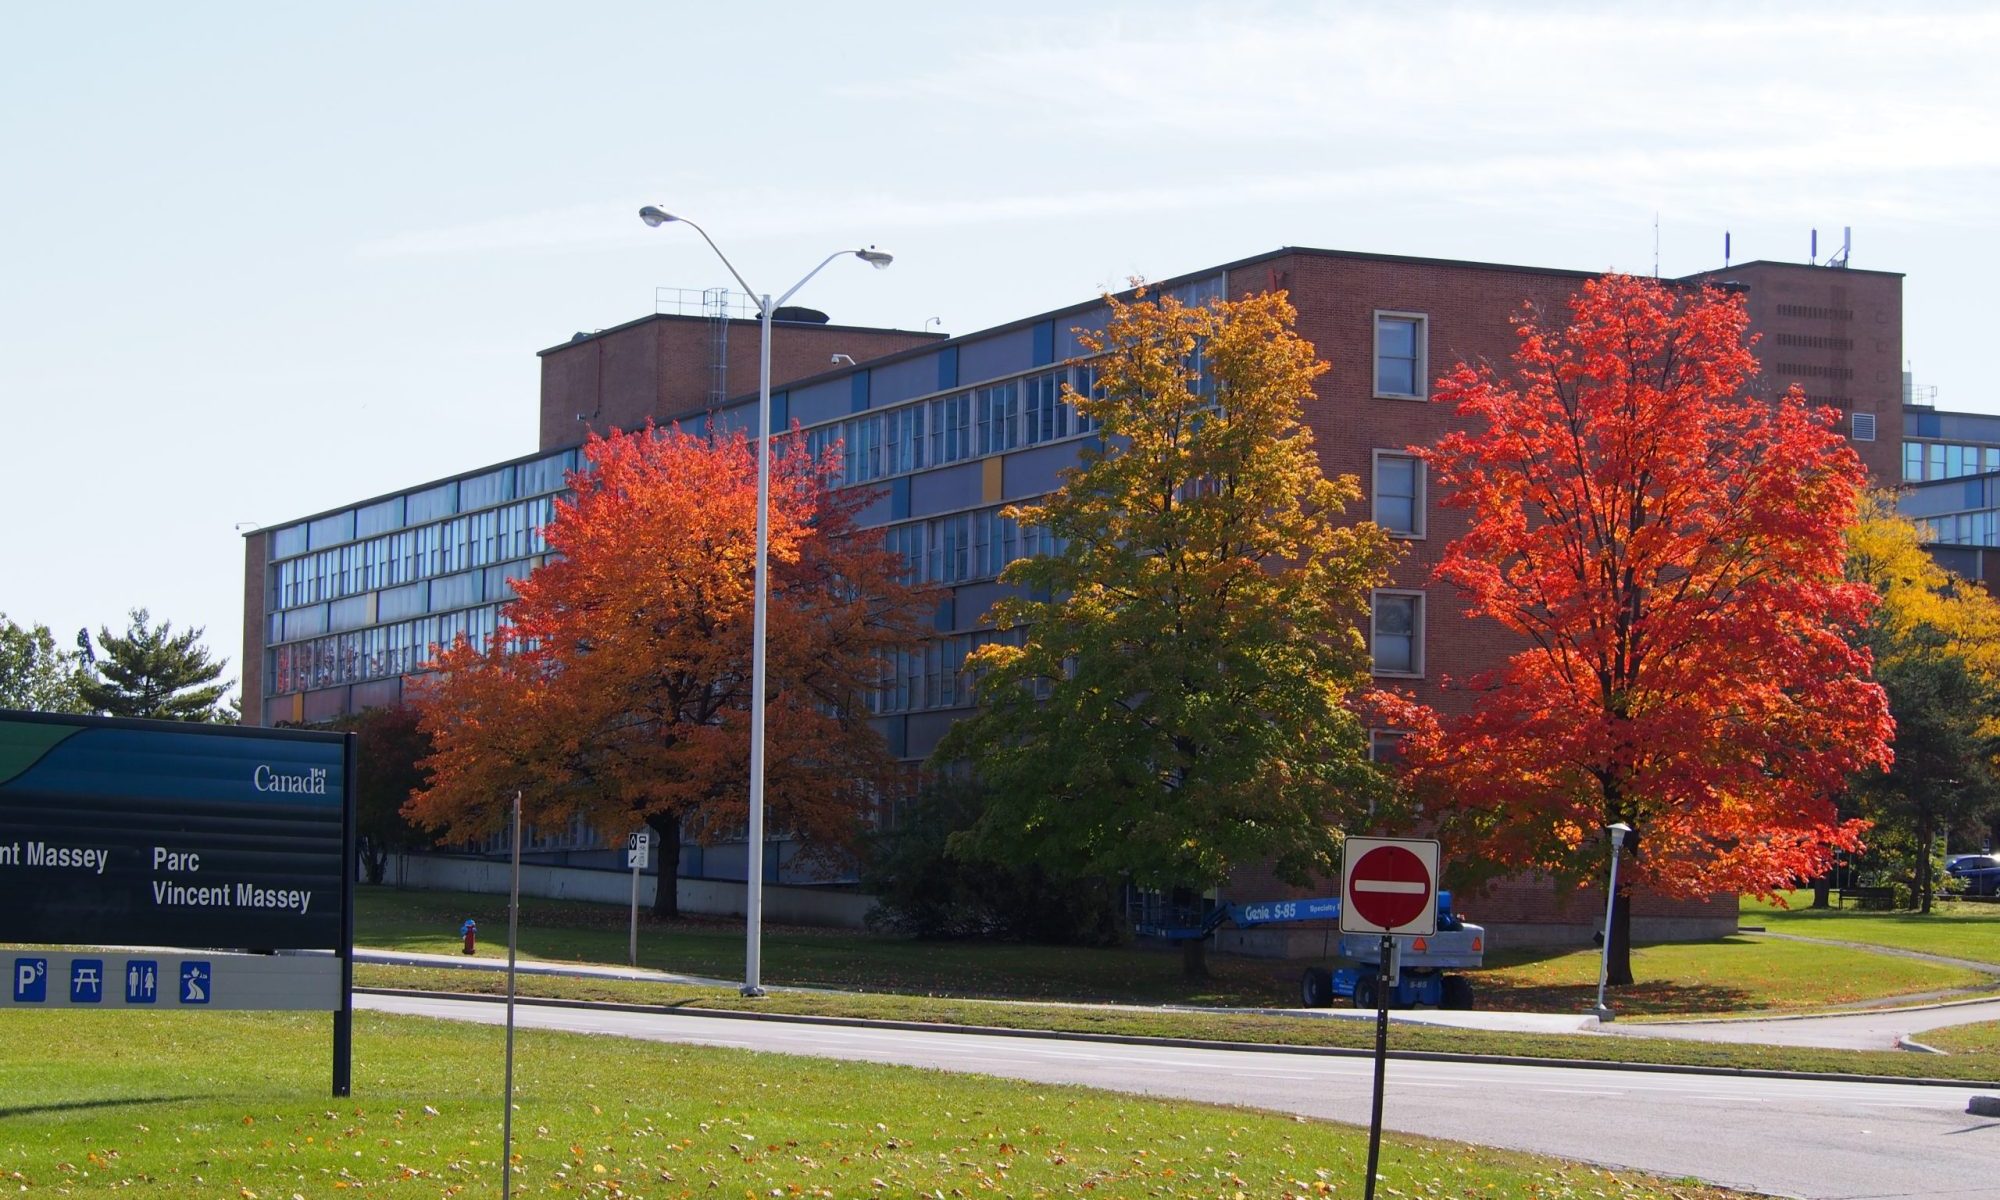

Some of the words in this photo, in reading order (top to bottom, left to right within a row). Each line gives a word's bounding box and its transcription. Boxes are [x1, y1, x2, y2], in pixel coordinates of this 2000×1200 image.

[254, 764, 327, 795] Canada
[27, 841, 109, 875] Massey
[153, 847, 200, 872] Parc
[152, 880, 230, 906] Vincent
[236, 883, 311, 915] Massey
[1245, 905, 1270, 921] Genie
[1274, 902, 1297, 919] S-85
